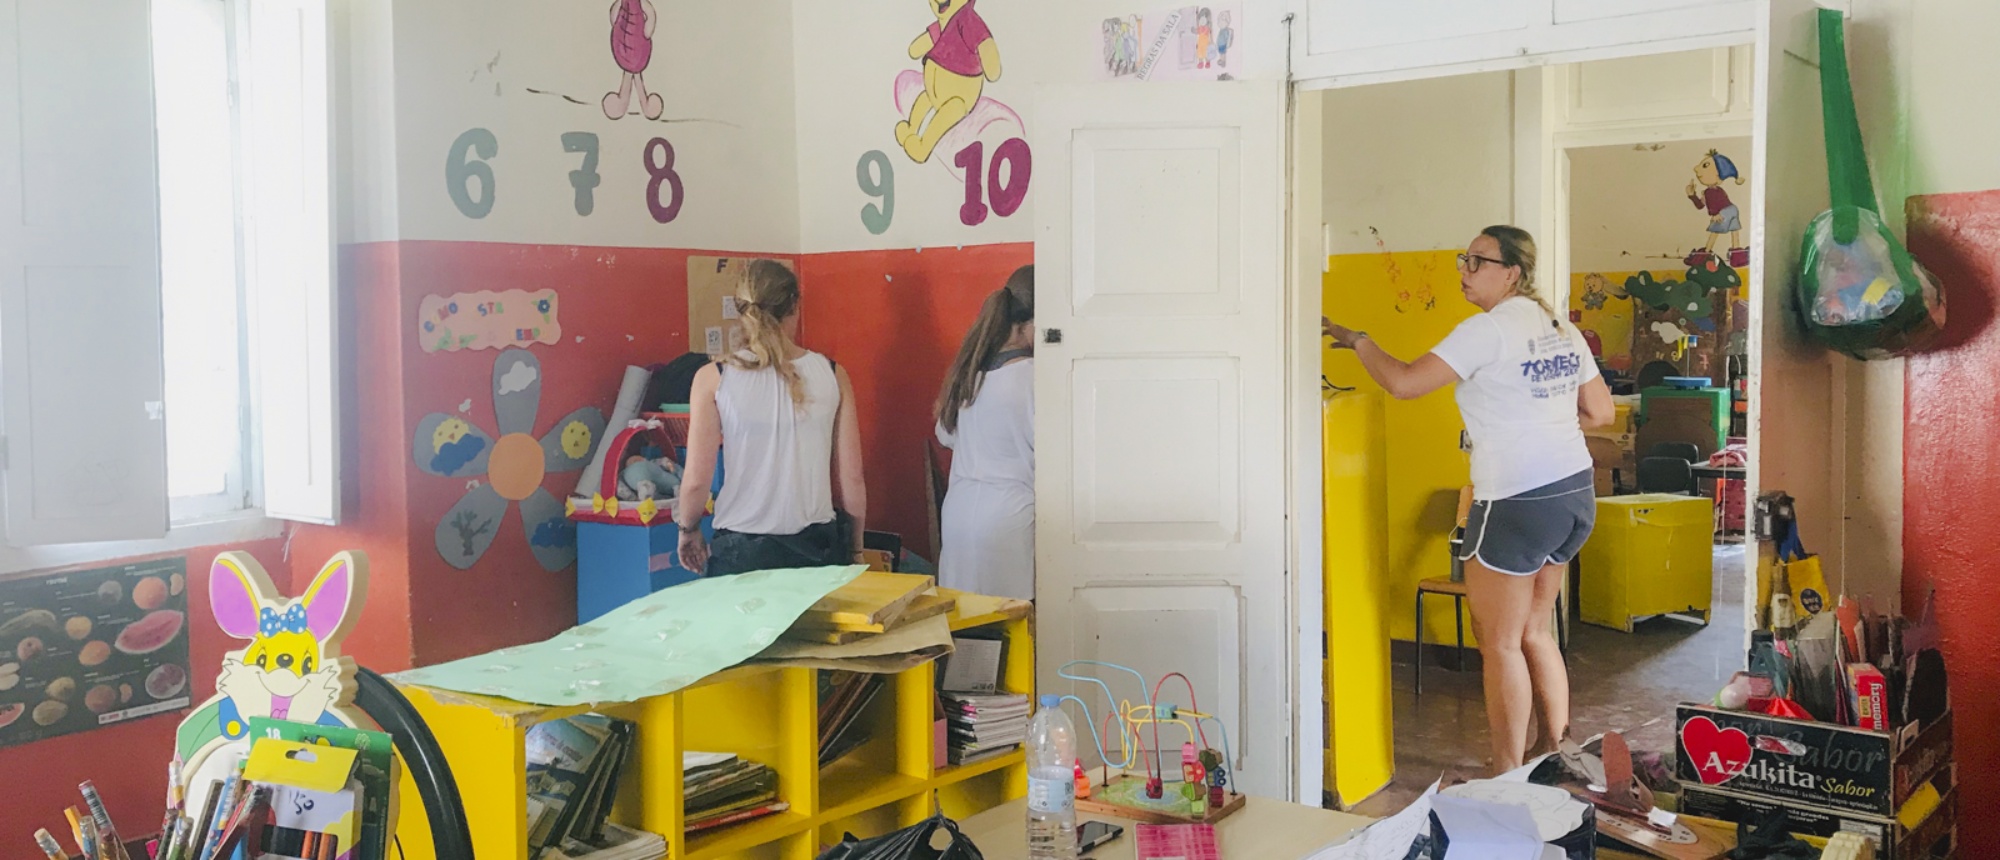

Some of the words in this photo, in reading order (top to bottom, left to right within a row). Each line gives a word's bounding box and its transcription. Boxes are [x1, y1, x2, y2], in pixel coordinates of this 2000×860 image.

[1163, 14, 1180, 36] SALA
[445, 128, 498, 219] 6
[561, 131, 600, 216] 7
[643, 137, 684, 223] 8
[856, 150, 895, 235] 9
[954, 137, 1032, 226] 10
[1870, 683, 1883, 731] memory
[1702, 752, 1816, 790] Azukita
[1820, 776, 1876, 799] Sabor
